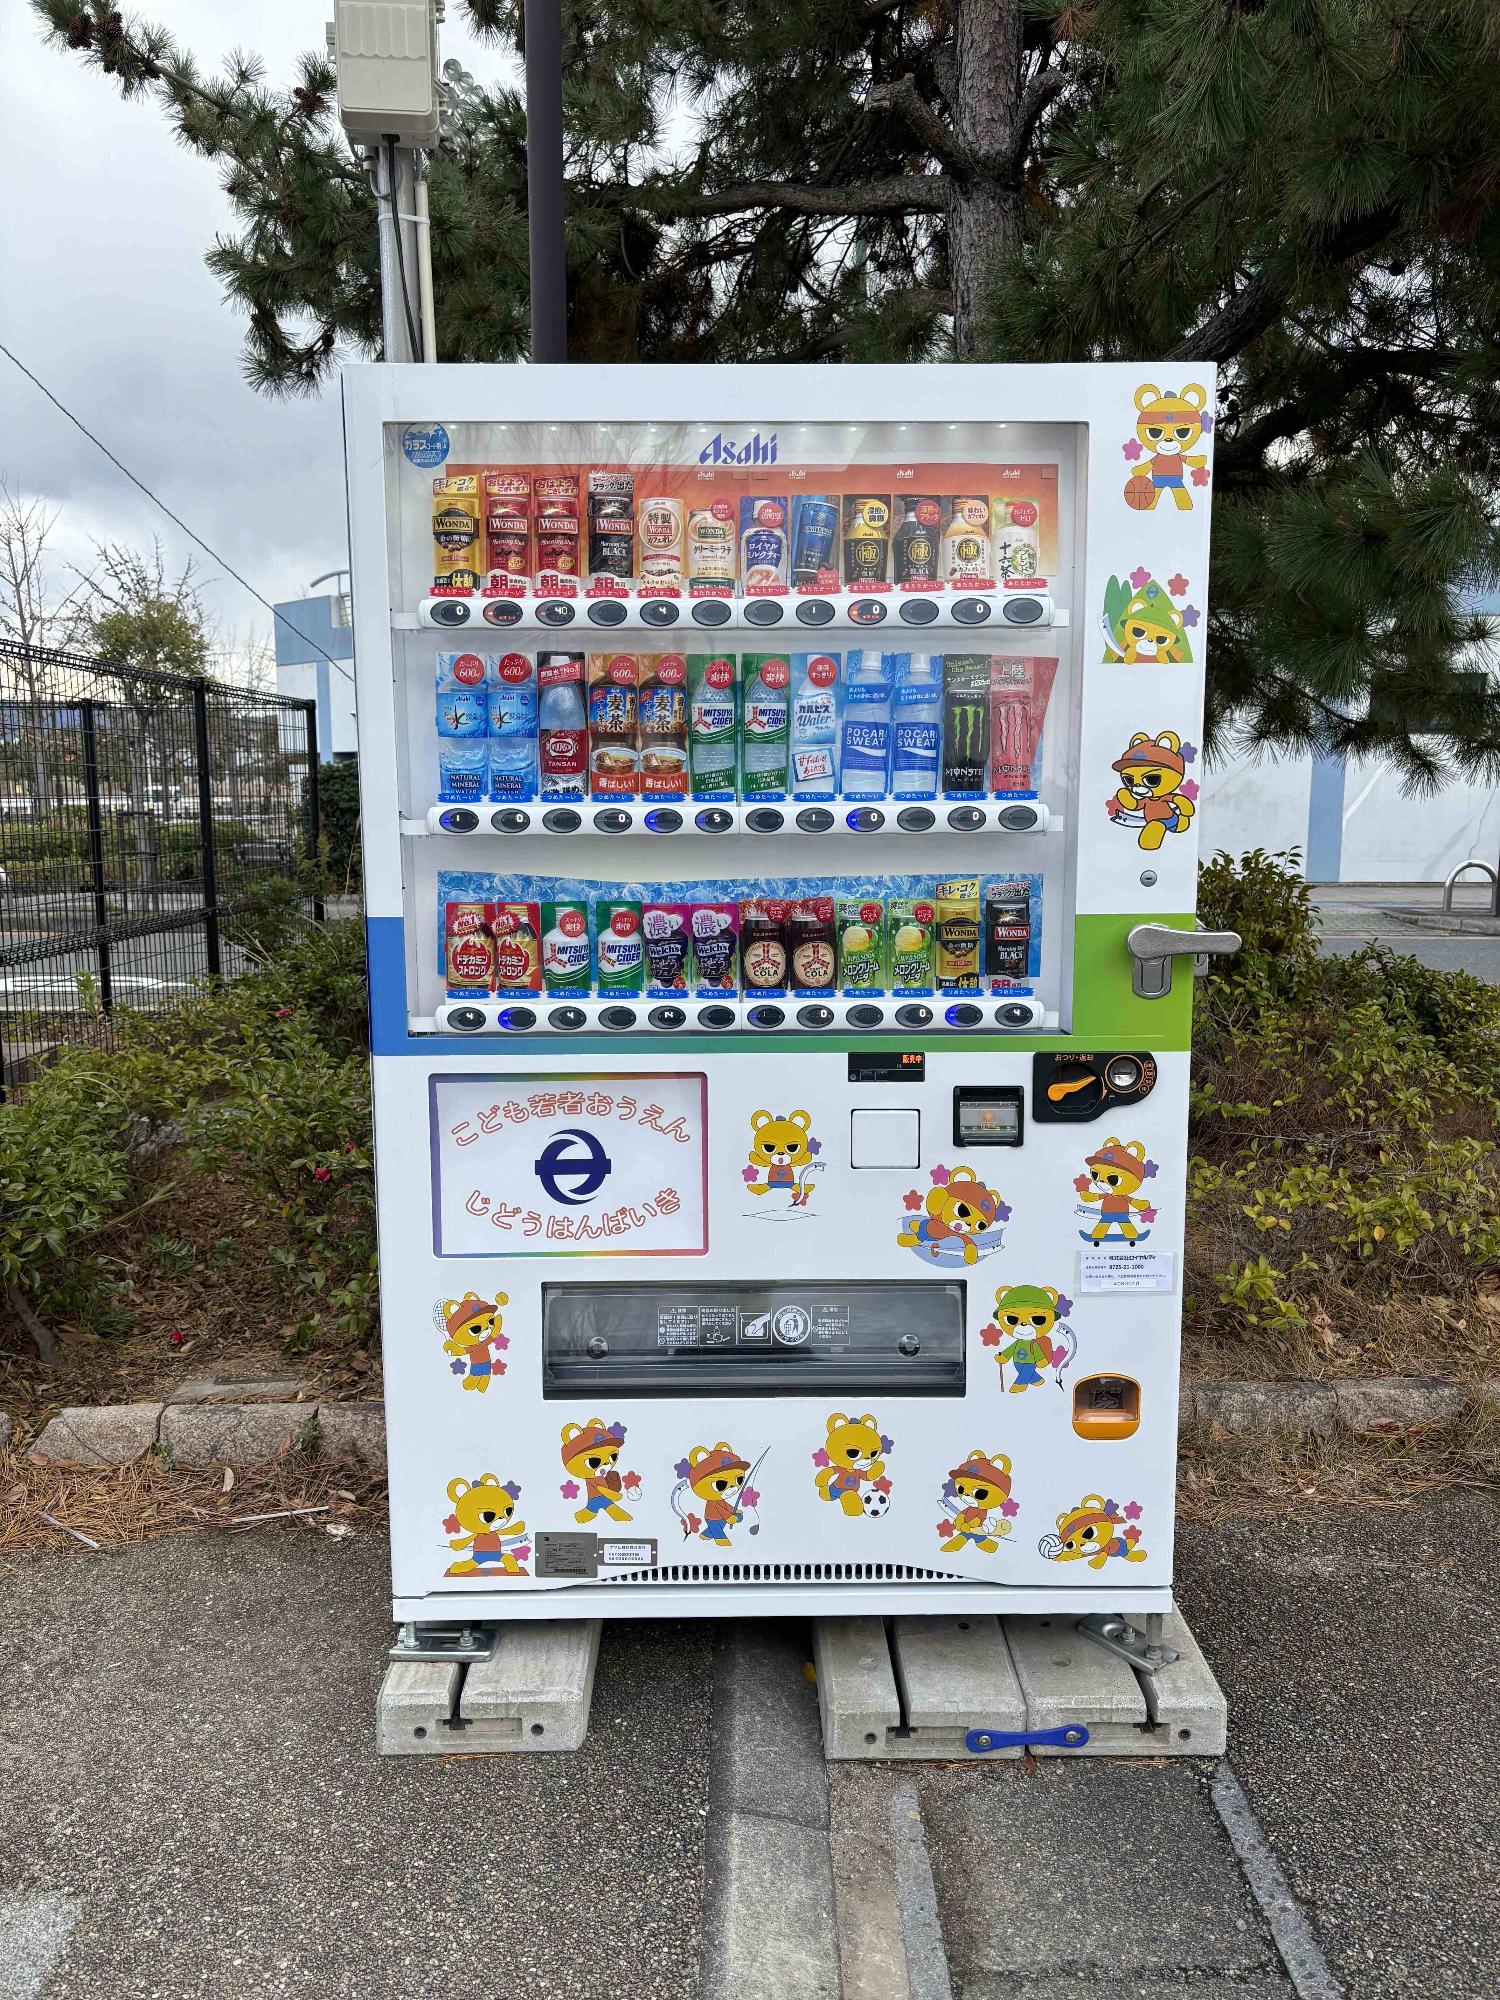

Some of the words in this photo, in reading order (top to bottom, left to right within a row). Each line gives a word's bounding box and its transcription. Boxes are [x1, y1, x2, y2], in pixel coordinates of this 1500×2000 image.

[699, 432, 777, 464] Asahi
[486, 479, 524, 487] おはよう
[536, 480, 573, 488] おはよう
[436, 518, 470, 529] WONDA
[648, 512, 672, 524] 特製
[491, 519, 525, 530] WONDA
[540, 519, 574, 530] WONDA
[600, 519, 630, 531] WONDA
[648, 525, 671, 534] WONDA
[648, 536, 672, 544] カフェオレ
[602, 547, 627, 556] BLACK
[693, 544, 731, 555] クリーミーラテ
[749, 542, 779, 550] ロイヤル
[911, 542, 929, 559] 極
[960, 542, 978, 559] 極
[747, 551, 780, 559] ミルクティー
[860, 545, 877, 562] 極
[999, 541, 1015, 580] 十六茶
[998, 664, 1025, 678] 上陸
[710, 673, 730, 682] 爽快
[766, 673, 784, 683] 爽快
[607, 694, 624, 731] 麦茶
[654, 694, 671, 731] 麦茶
[703, 708, 733, 717] MITSUYA
[799, 705, 832, 714] カルピス
[711, 716, 733, 725] CIDER
[797, 714, 832, 728] Water
[847, 738, 884, 746] SWEAT
[898, 738, 935, 747] SWEAT
[946, 767, 983, 776] MONSTE
[993, 764, 1031, 773] MONSTE
[599, 777, 634, 789] 香ばしい!
[645, 777, 682, 789] 香ばしい!
[565, 923, 581, 932] 爽快
[616, 923, 631, 931] 爽快
[647, 915, 680, 935] 濃い
[695, 914, 727, 935] 濃い
[945, 927, 977, 937] WONDA
[997, 927, 1027, 937] WONDA
[607, 943, 640, 954] MITSUYA
[649, 945, 680, 957] Welch's
[698, 944, 728, 955] Welch's
[456, 954, 487, 965] ドデカミン
[498, 954, 525, 965] ドデカミン
[617, 953, 640, 963] CIDER
[1000, 951, 1023, 960] BLACK
[651, 958, 678, 970] ぶどう
[700, 957, 725, 969] ぶどう
[844, 961, 879, 976] メロンクリーム
[894, 961, 930, 976] メロンクリーム
[458, 965, 486, 976] ストロング
[499, 965, 523, 976] ストロング
[853, 974, 870, 984] ソーダ
[903, 973, 921, 983] ソーダ
[902, 1054, 922, 1064] 販売中
[1054, 1053, 1094, 1061] おつり・返却
[451, 1091, 690, 1146] こども若者おうえん
[465, 1188, 681, 1240] じどうはんばいき
